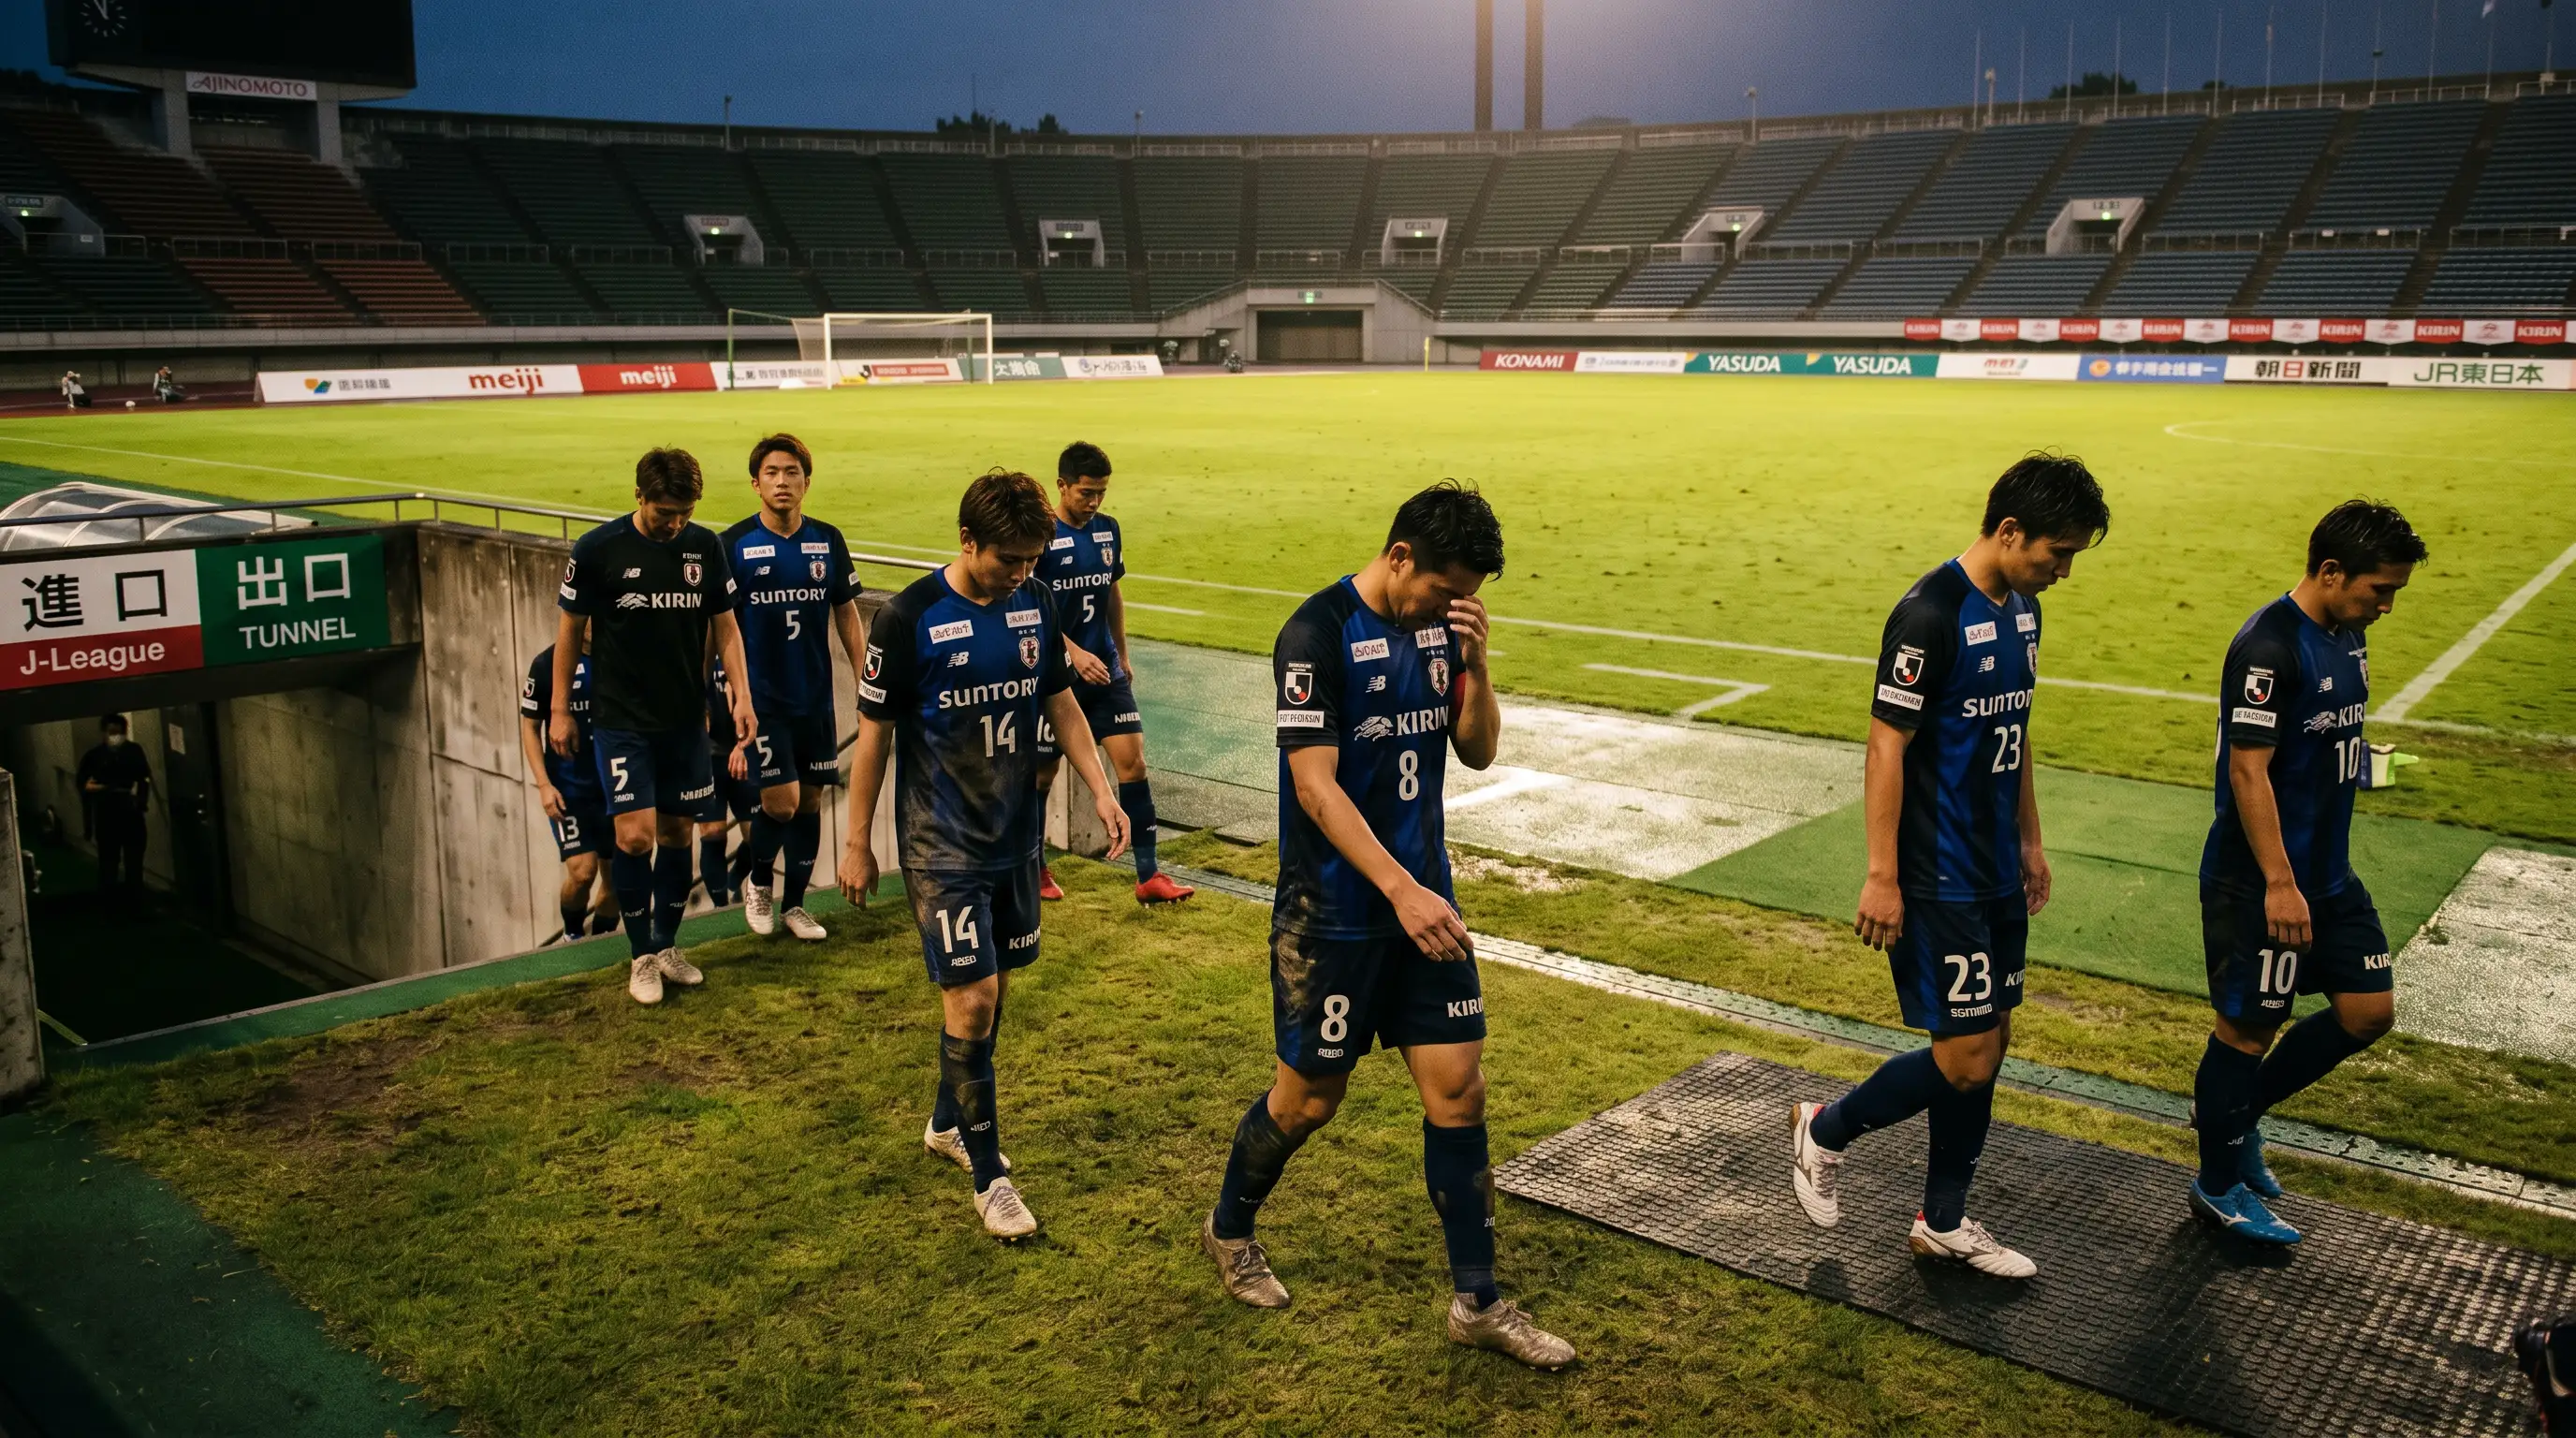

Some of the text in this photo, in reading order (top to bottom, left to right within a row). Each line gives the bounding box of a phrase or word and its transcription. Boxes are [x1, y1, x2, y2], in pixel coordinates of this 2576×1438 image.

[192, 75, 308, 96] AJINOMOTO
[2518, 326, 2562, 337] KIRIN
[620, 365, 677, 389] meiji
[1495, 354, 1565, 369] KONAMI
[1707, 355, 1781, 373] YASUDA
[1832, 356, 1912, 374] YASUDA
[2414, 362, 2544, 385] JR東日本
[469, 368, 544, 396] meiji
[237, 552, 351, 610] 出口
[21, 569, 168, 632] 進口
[651, 593, 702, 609] KIRIN
[1082, 594, 1095, 624] 5
[238, 616, 357, 650] TUNNEL
[785, 609, 801, 640] 5
[20, 641, 166, 675] J-League
[979, 711, 1017, 758] 14
[1397, 705, 1449, 737] KIRIN
[755, 736, 773, 768] 5
[1991, 724, 2022, 773] 23
[2334, 736, 2361, 785] 10
[610, 756, 629, 792] 5
[1398, 750, 1419, 800] 8
[558, 815, 579, 842] 13
[935, 905, 980, 954] 14
[1944, 952, 1992, 1002] 23
[2258, 948, 2297, 994] 10
[1321, 994, 1350, 1042] 8
